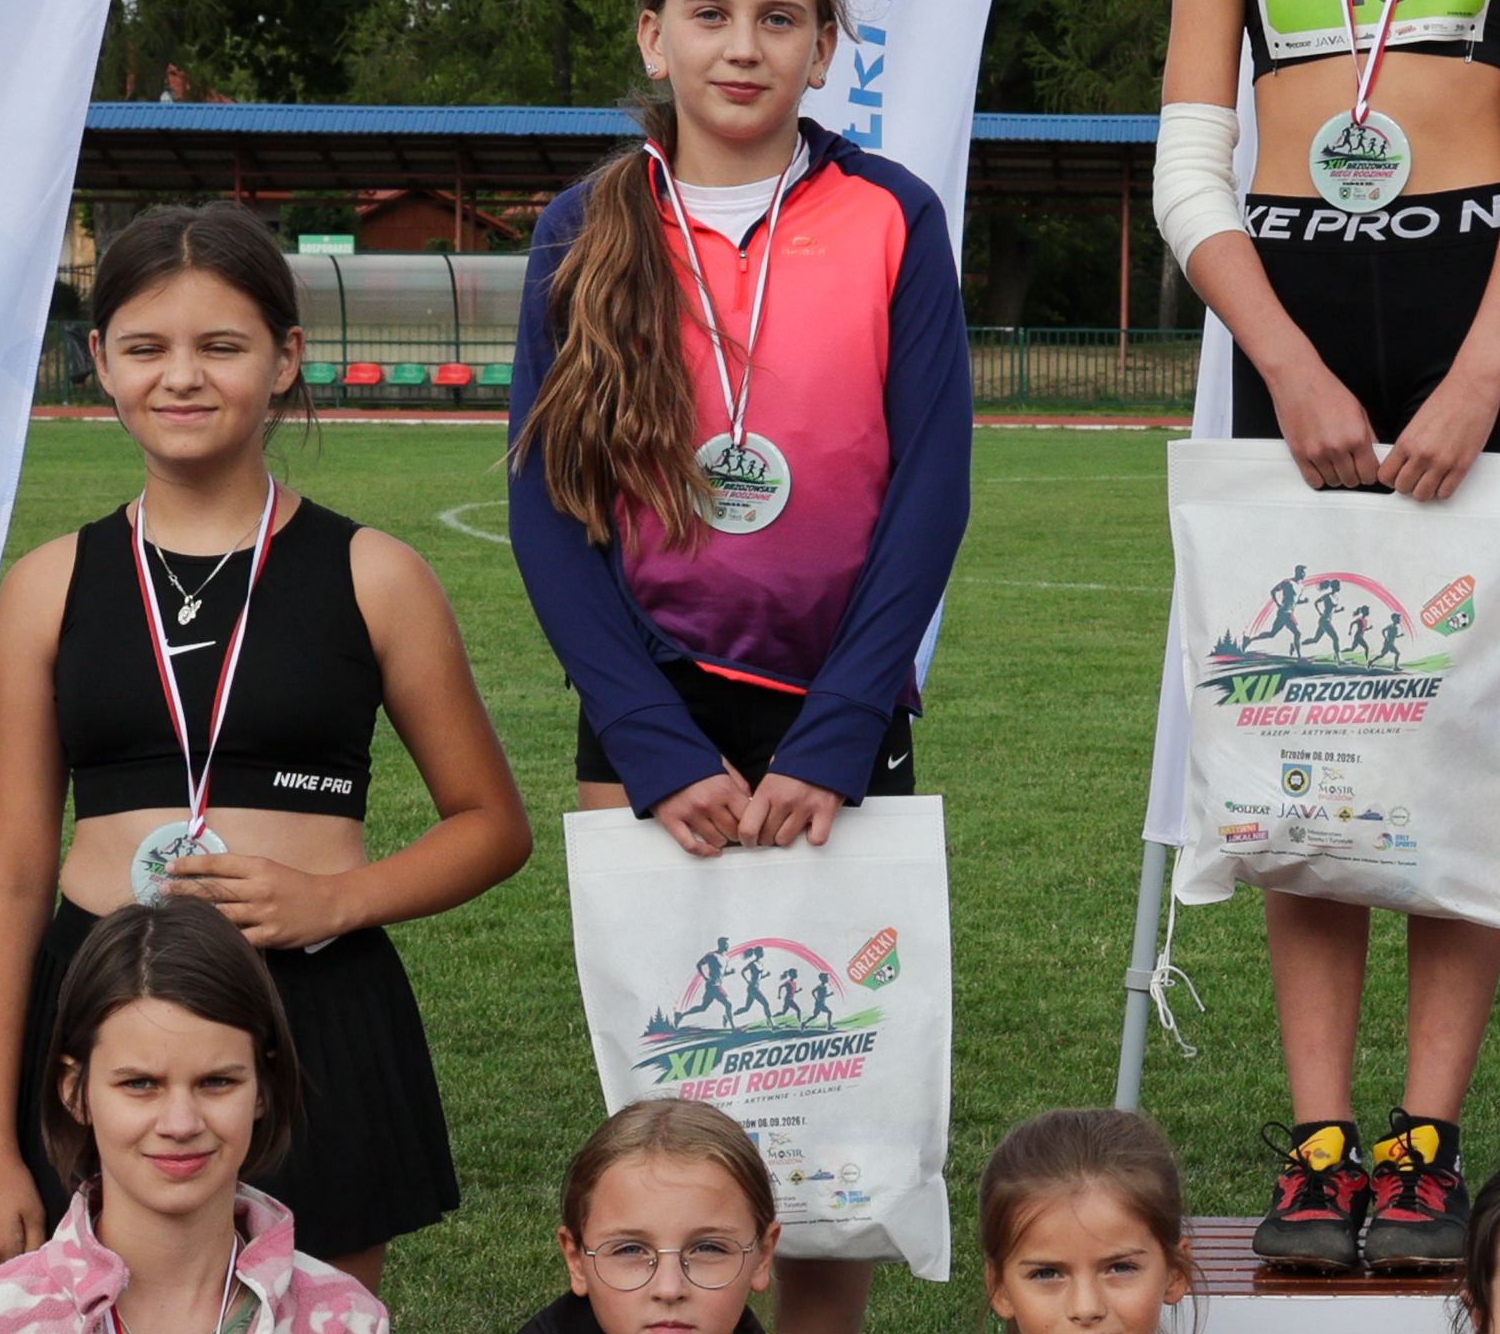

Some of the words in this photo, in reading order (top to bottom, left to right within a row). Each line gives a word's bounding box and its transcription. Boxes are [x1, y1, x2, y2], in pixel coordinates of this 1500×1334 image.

[1314, 35, 1345, 48] JAVA
[1303, 206, 1440, 242] PRO
[1422, 579, 1473, 625] ORZEŁKI
[1223, 674, 1282, 705] XII
[1284, 677, 1443, 703] BRZOZOWSKIE
[1236, 706, 1301, 727] BIEGI
[1304, 701, 1429, 726] RODZINNE
[1301, 728, 1347, 736] AKTYWNIE
[1358, 727, 1401, 735] LOKALNIE
[1280, 749, 1311, 761] Brzozów
[273, 771, 319, 792] NIKE
[320, 776, 353, 795] PRO
[1277, 803, 1329, 821] JAVA
[850, 931, 896, 981] ORZEŁKI
[662, 1047, 718, 1083] XII
[723, 1031, 878, 1075] BRZOZOWSKIE
[679, 1076, 741, 1102] BIEGI
[745, 1057, 866, 1094] RODZINNE
[743, 1092, 789, 1105] AKTYWNIE
[800, 1085, 842, 1098] LOKALNIE
